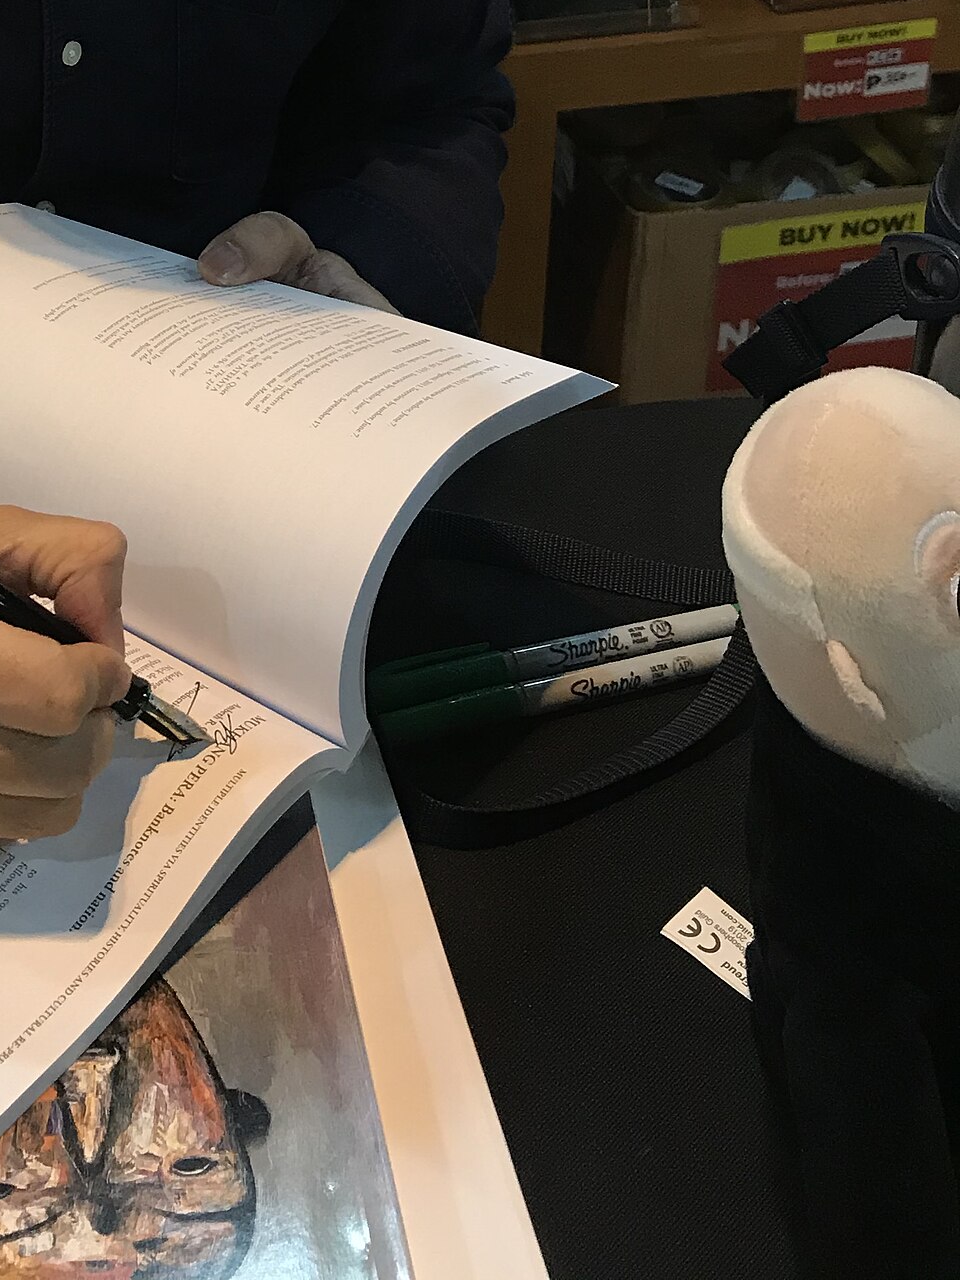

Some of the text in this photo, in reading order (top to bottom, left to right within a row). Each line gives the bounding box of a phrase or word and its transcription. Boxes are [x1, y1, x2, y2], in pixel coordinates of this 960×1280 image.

[836, 26, 908, 44] BUY NOW!
[804, 78, 863, 101] Now:
[779, 211, 915, 246] BUY NOW!
[209, 767, 247, 808] MULTIPLE
[67, 714, 265, 932] MUKHANG PERA: Banknotes and nation.
[174, 804, 214, 854] IDENTITIES
[26, 868, 38, 879] to
[162, 852, 178, 870] VIA
[11, 882, 26, 895] his
[117, 868, 167, 931] SPIRITUALITY,
[694, 909, 714, 927] Guild
[720, 908, 755, 938] uild.com
[677, 916, 722, 954] CE
[727, 925, 748, 943] 2019
[80, 931, 121, 978] HISTORIES
[63, 975, 83, 996] AND
[21, 993, 67, 1038] CULTURAL
